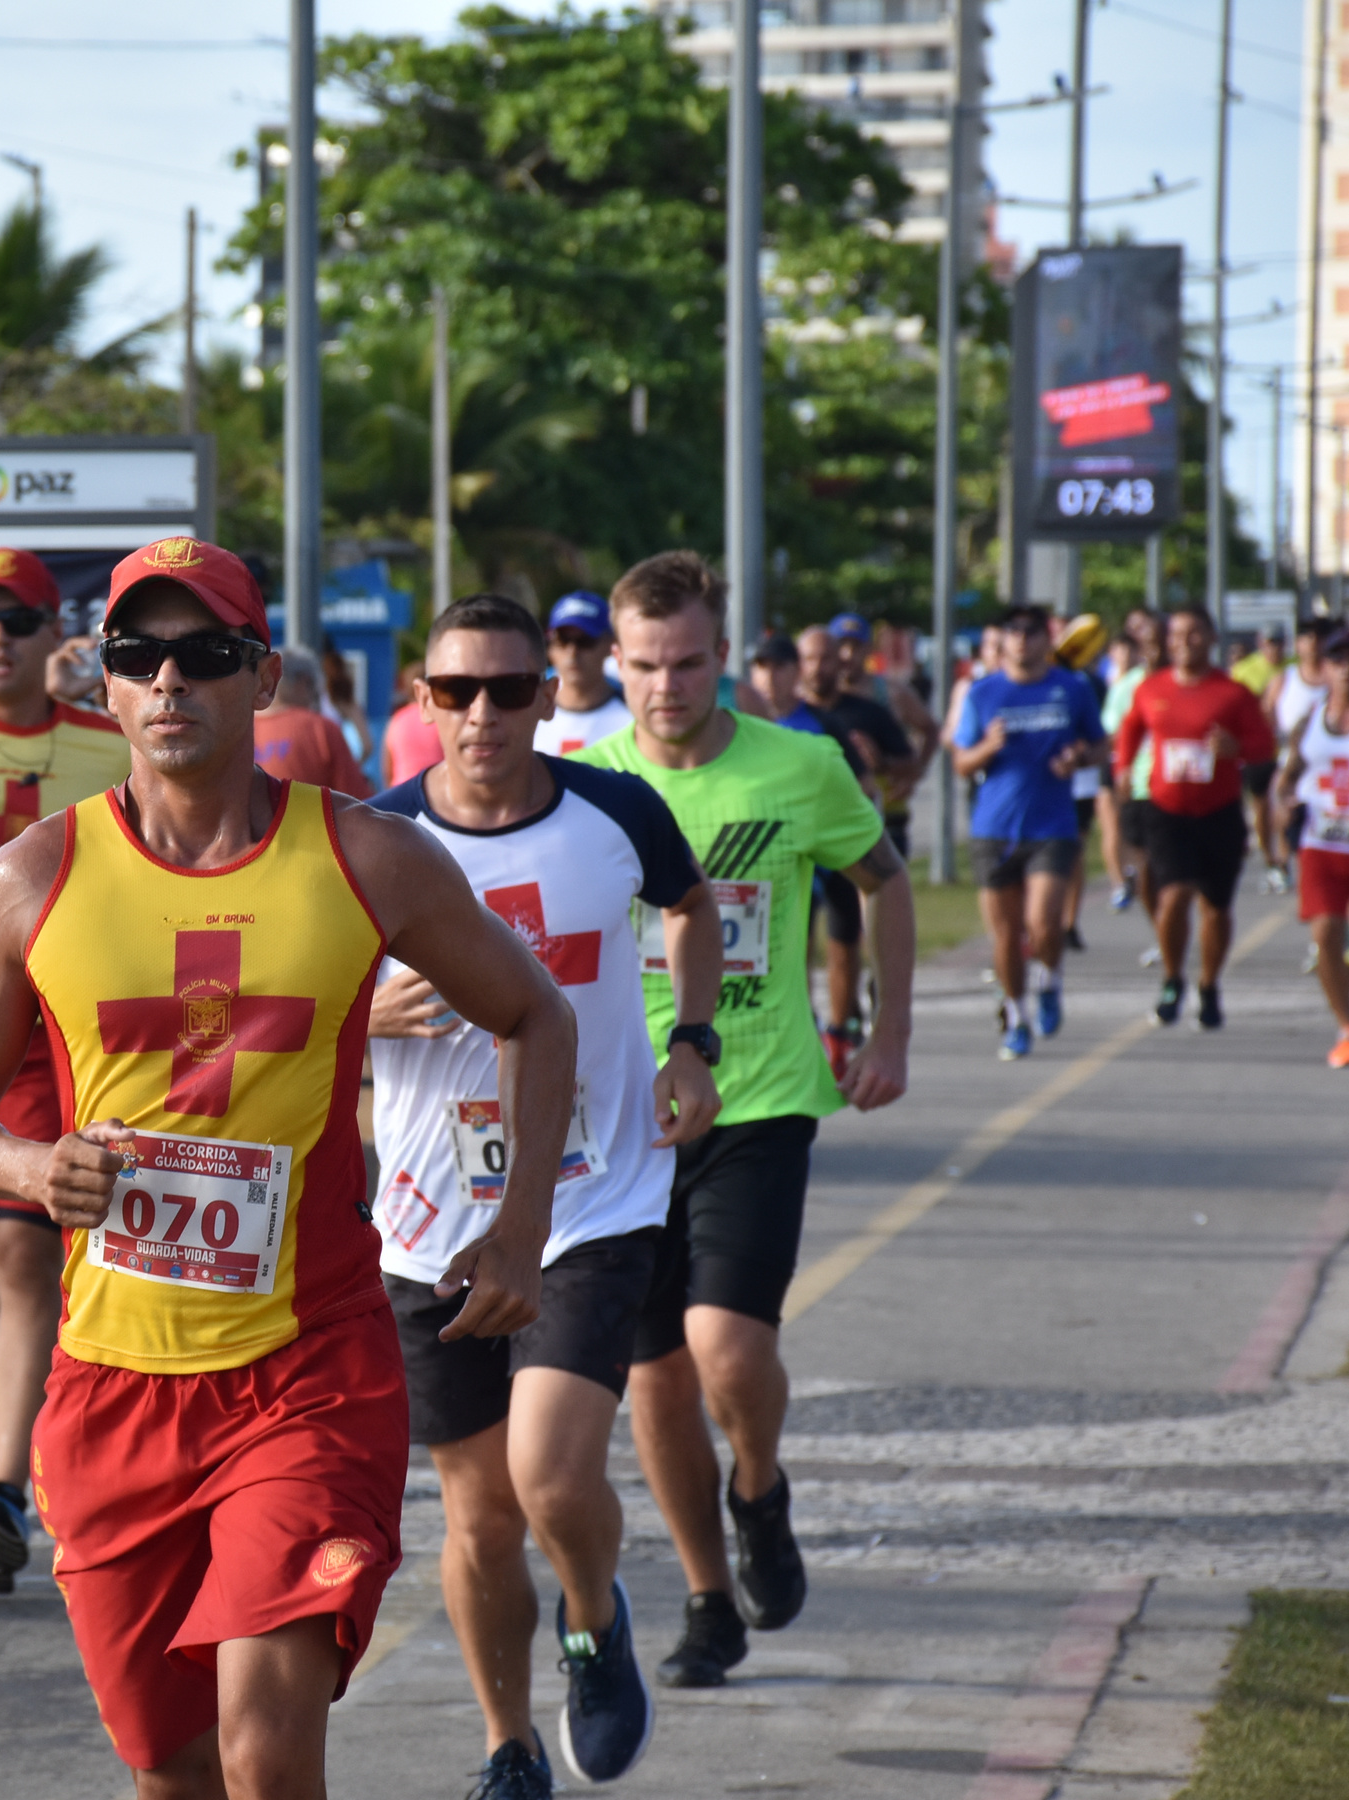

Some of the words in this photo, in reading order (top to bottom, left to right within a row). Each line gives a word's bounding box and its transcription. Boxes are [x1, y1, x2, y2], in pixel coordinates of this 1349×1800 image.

[14, 470, 76, 502] paz
[1057, 478, 1154, 517] 07:43
[224, 914, 256, 925] BRUNO
[160, 1141, 174, 1154] 1ª
[177, 1143, 238, 1162] CORRIDA
[482, 1139, 506, 1174] 0
[154, 1156, 242, 1176] GUARDA-VIDAS
[253, 1167, 270, 1181] 5K
[271, 1192, 279, 1210] VALE
[122, 1189, 240, 1250] 070
[266, 1211, 277, 1248] MEDALHA
[136, 1240, 216, 1264] GUARDA-VIDAS
